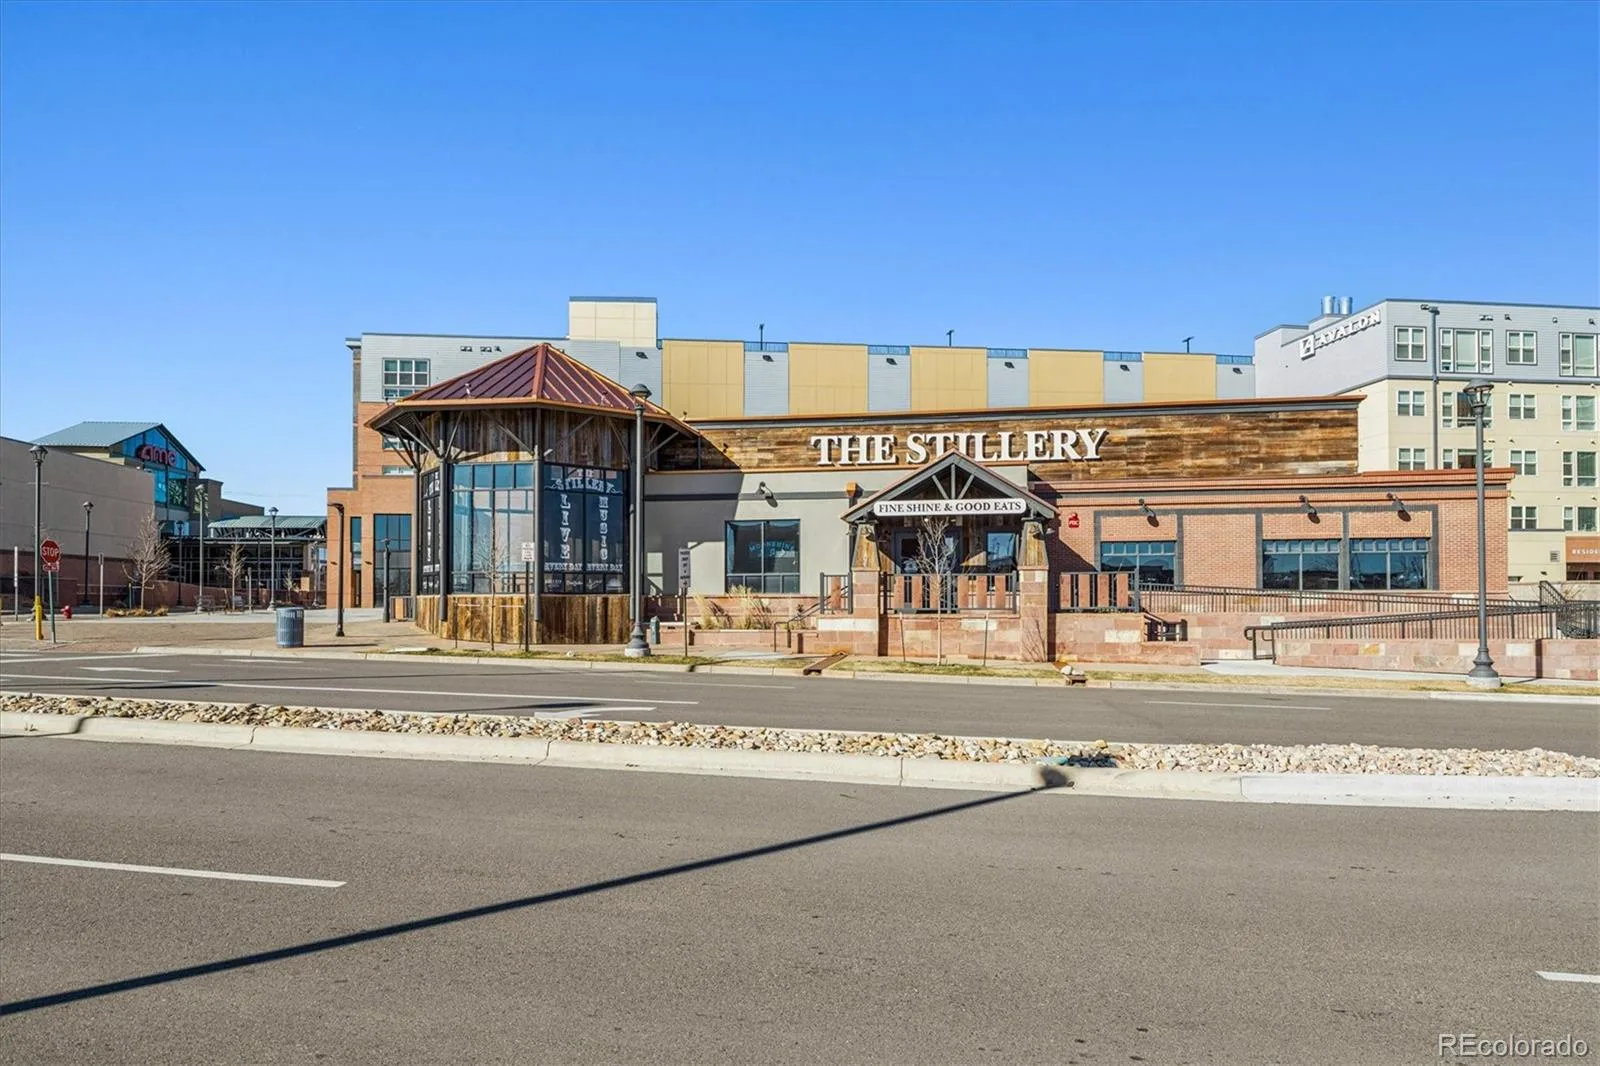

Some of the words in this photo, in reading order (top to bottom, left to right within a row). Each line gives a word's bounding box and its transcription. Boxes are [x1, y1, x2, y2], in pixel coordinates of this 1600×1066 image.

[1314, 309, 1381, 350] AVALON
[811, 434, 897, 467] THE
[906, 427, 1107, 464] STILLERY
[879, 504, 905, 513] FINE
[907, 503, 941, 513] SHINE
[944, 502, 953, 512] &
[955, 501, 991, 512] GOOD
[994, 501, 1022, 511] EATS
[42, 546, 60, 557] STOP
